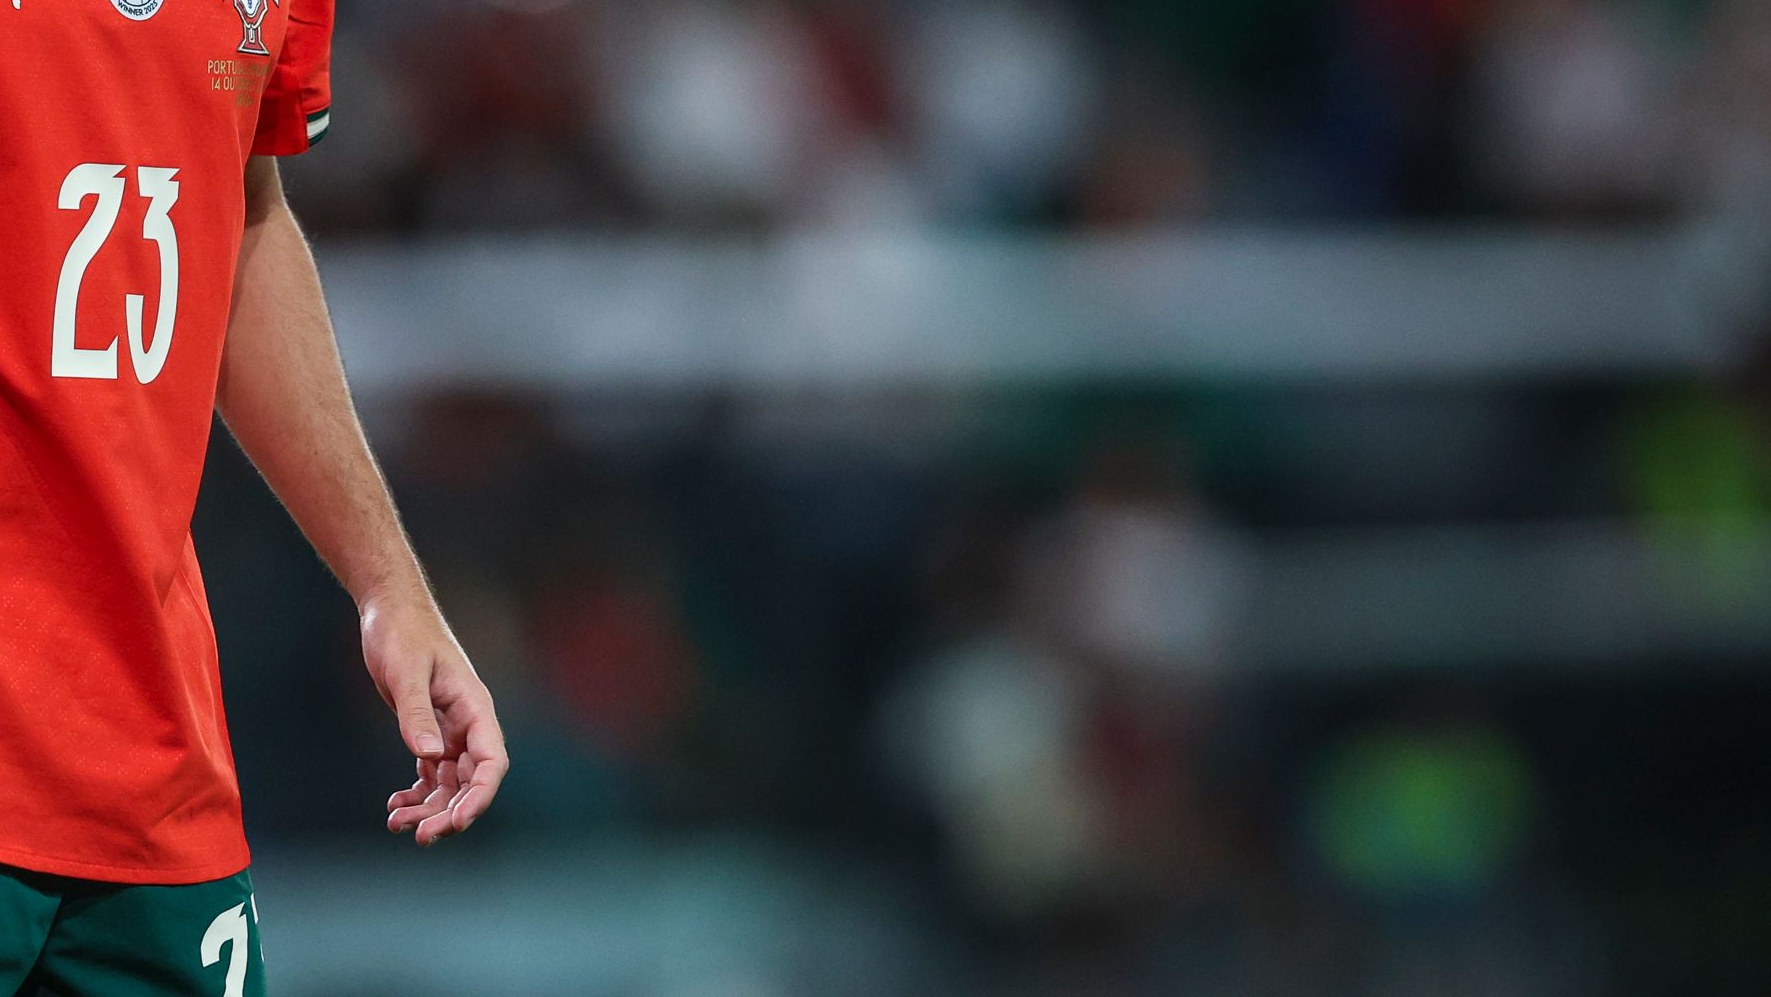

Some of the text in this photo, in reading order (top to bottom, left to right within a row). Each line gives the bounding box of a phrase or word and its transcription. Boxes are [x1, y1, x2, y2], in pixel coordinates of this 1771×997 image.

[118, 0, 158, 16] WINNER 2025
[211, 77, 221, 91] 14
[51, 162, 180, 385] 23
